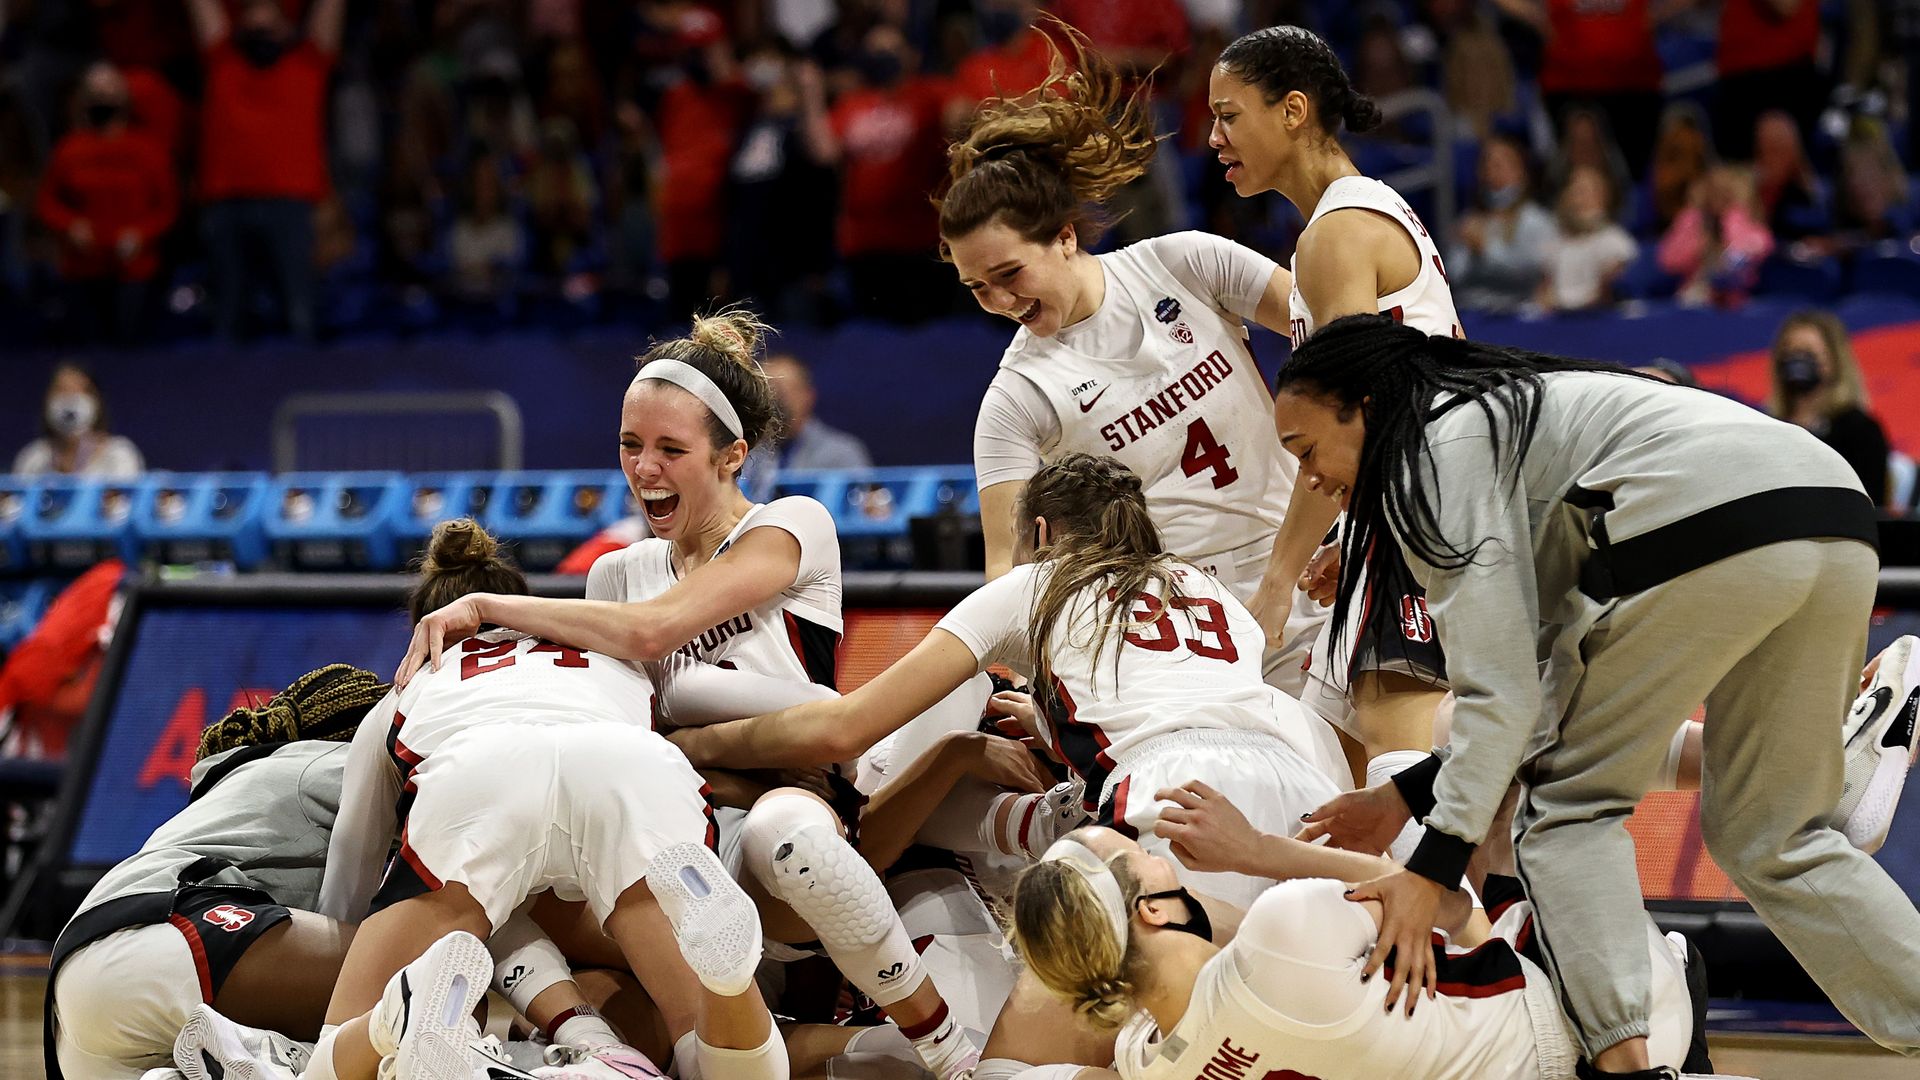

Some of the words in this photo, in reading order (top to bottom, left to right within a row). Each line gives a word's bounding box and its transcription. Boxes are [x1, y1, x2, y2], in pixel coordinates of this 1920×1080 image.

[1100, 350, 1233, 451] STANFORD
[1181, 436, 1239, 490] 4
[1107, 587, 1239, 664] 33
[1194, 1037, 1260, 1080] OME
